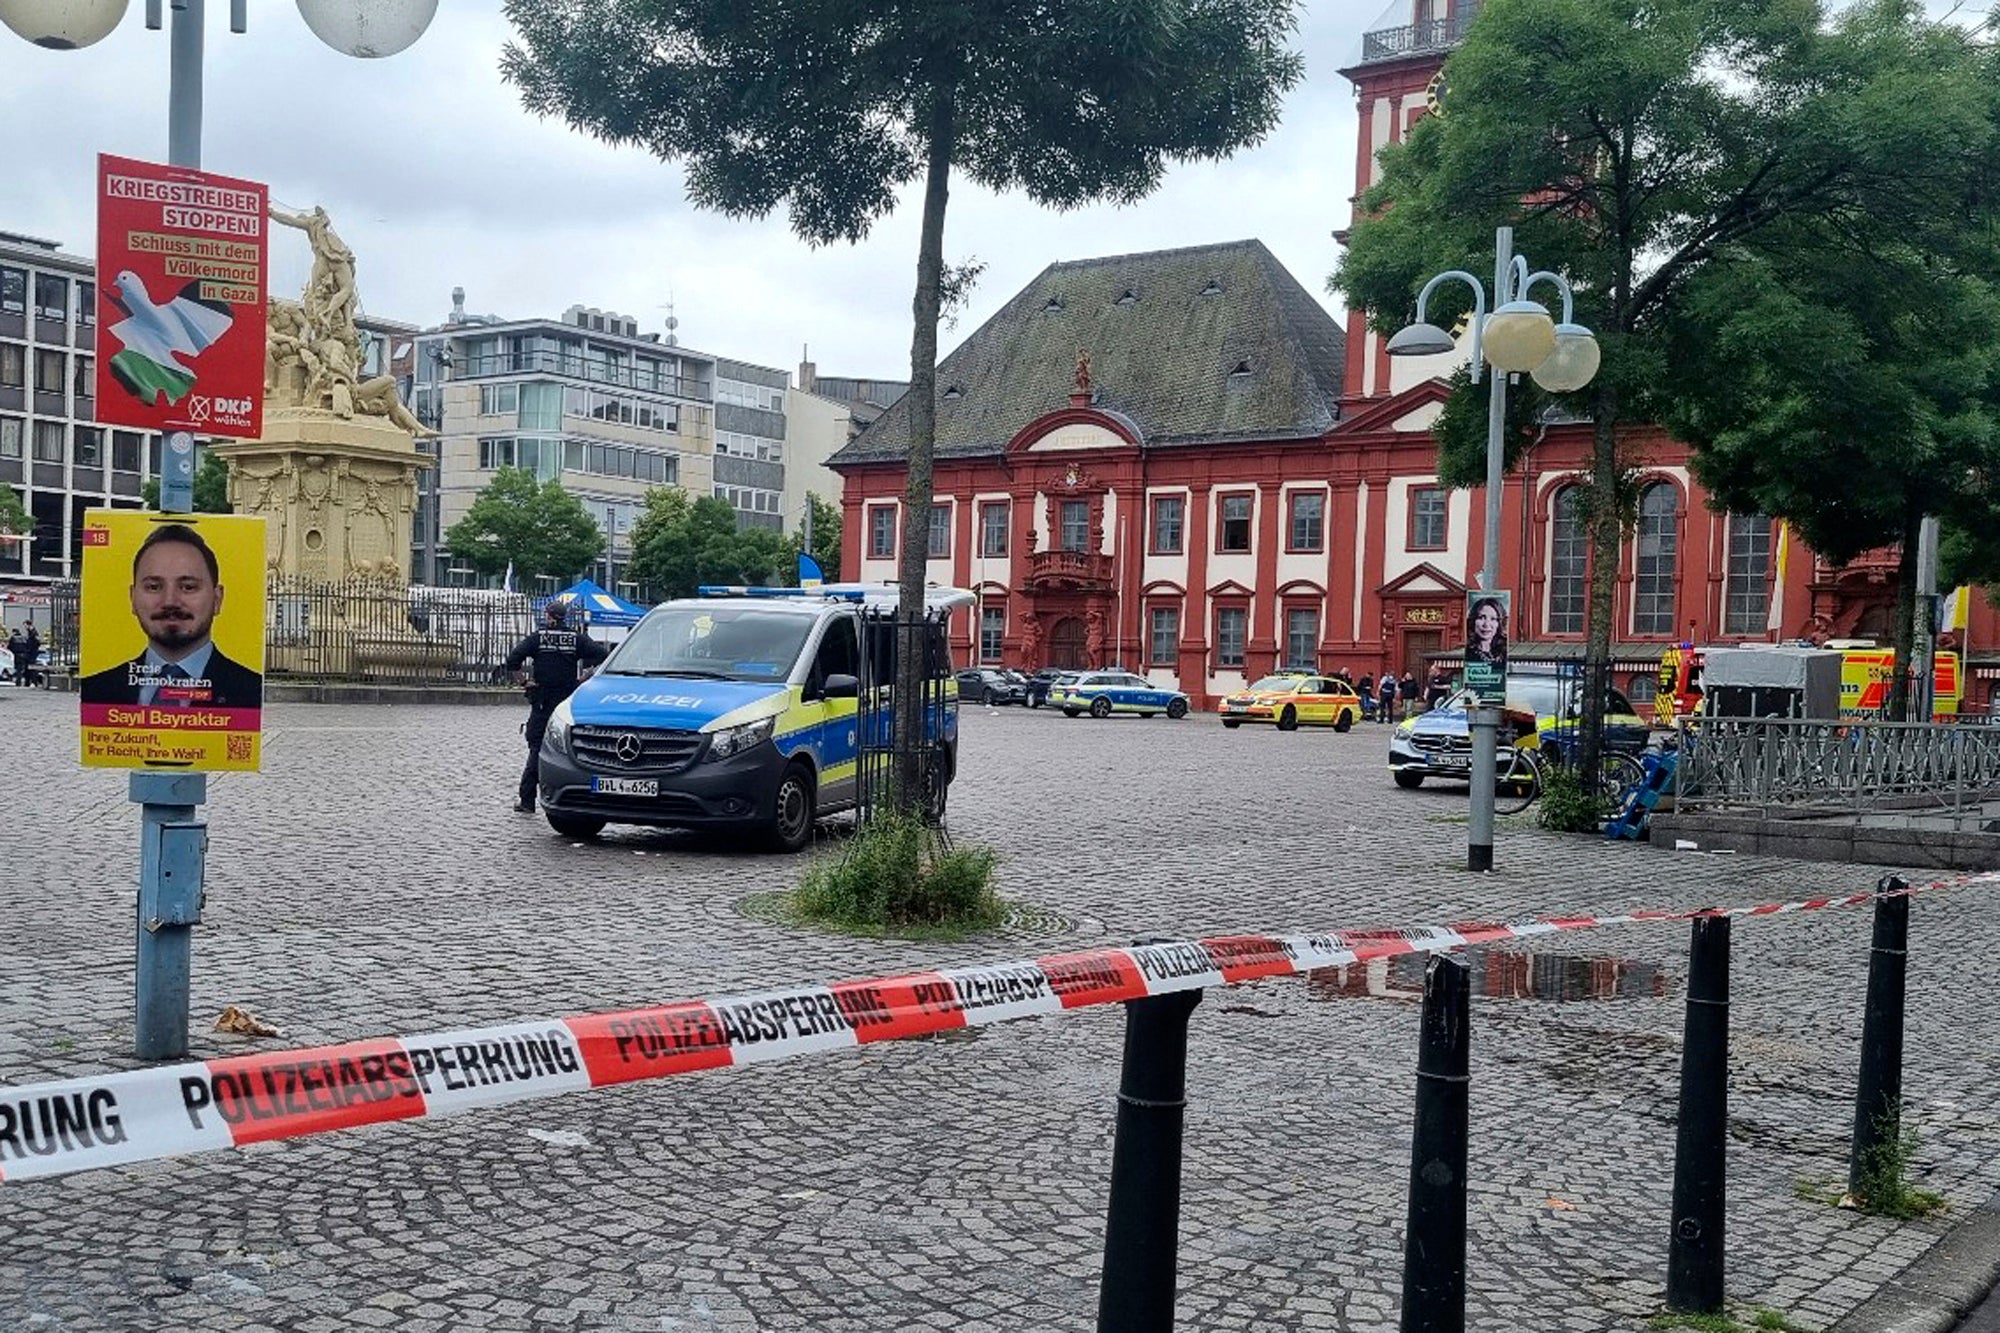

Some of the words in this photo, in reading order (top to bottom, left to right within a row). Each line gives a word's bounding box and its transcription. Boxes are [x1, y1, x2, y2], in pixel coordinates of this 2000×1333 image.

[110, 179, 257, 211] KRIEGSTREIBER
[165, 209, 256, 234] STOPPEN!
[131, 235, 191, 252] Schluss
[196, 242, 221, 256] mit
[225, 245, 256, 260] dem
[168, 260, 256, 281] Völkermord
[202, 283, 216, 298] in
[221, 286, 256, 301] Gaza
[214, 397, 252, 415] DKP
[214, 415, 251, 427] wählen
[92, 532, 106, 543] 18
[128, 662, 161, 674] Freie
[128, 674, 212, 688] Demokraten
[600, 692, 704, 709] POLIZEI
[150, 710, 232, 728] Bayraktar
[87, 732, 110, 742] Ihre
[113, 732, 161, 746] Zukunft,
[88, 745, 104, 755] Ihr
[107, 745, 144, 759] Recht,
[147, 748, 170, 759] Ihre
[179, 1028, 580, 1130] POLIZEIABSPERRUNG
[608, 986, 894, 1064] POLIZEIABSPERRUNG
